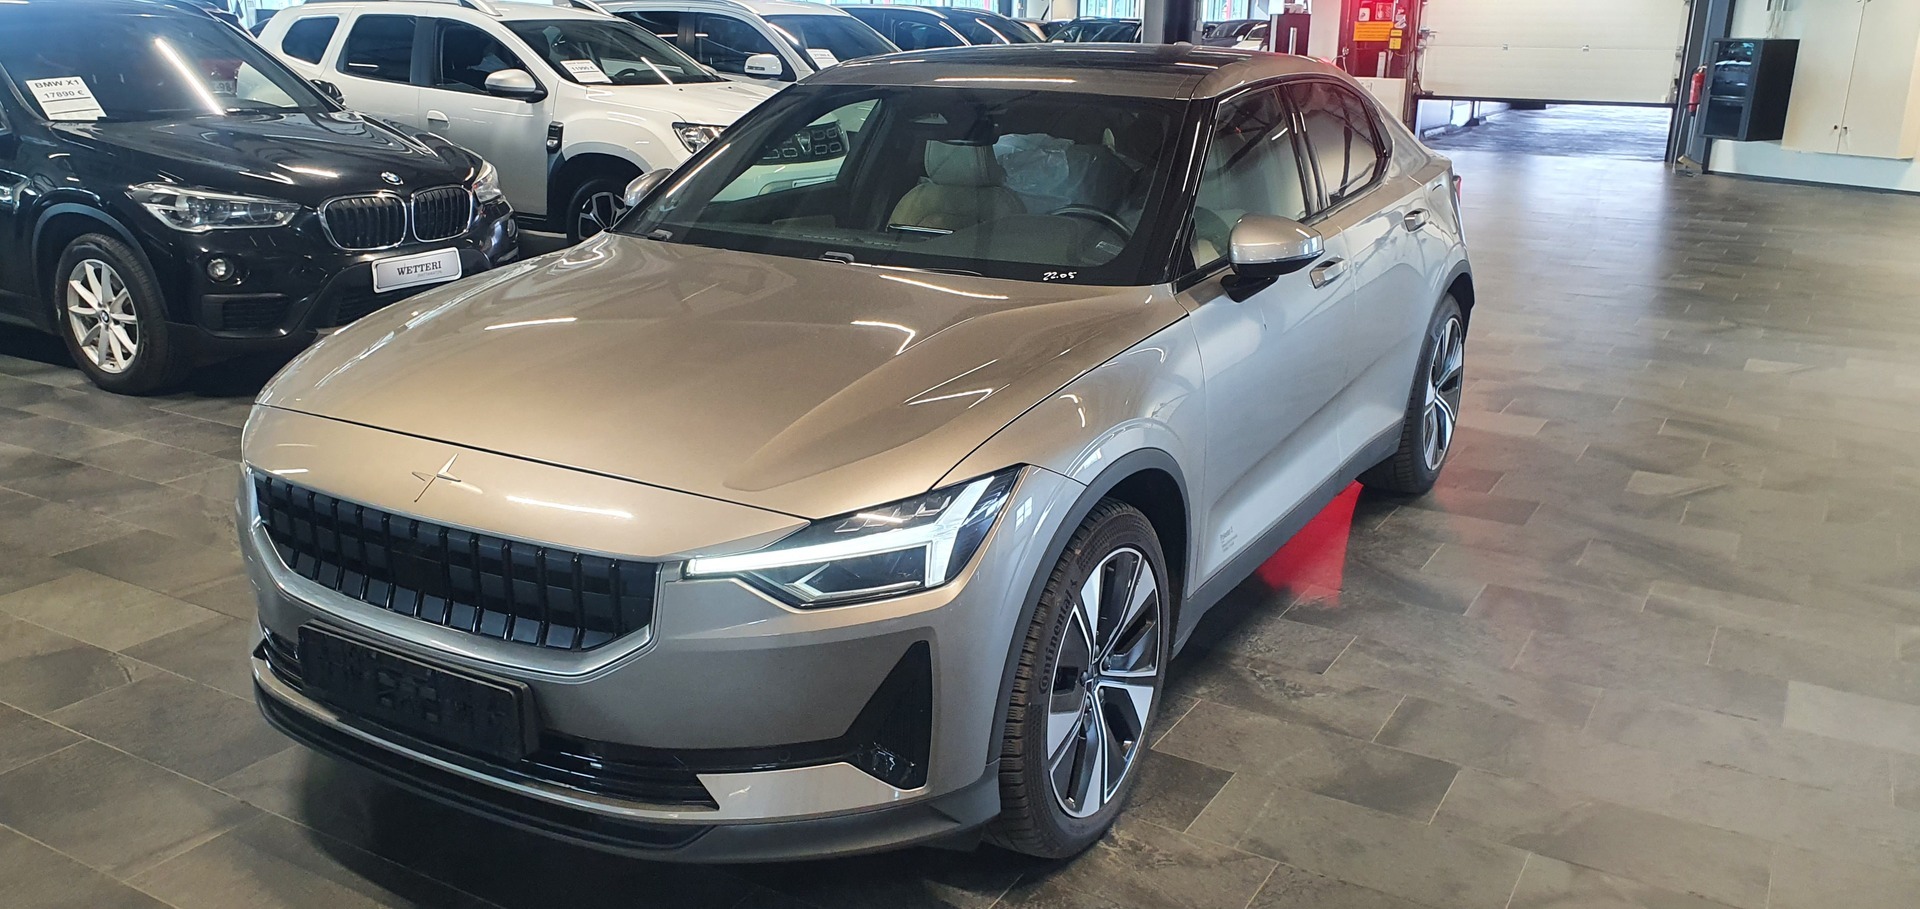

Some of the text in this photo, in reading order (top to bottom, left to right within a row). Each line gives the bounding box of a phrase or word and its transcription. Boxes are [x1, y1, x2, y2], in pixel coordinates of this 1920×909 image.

[34, 80, 63, 89] BMW
[44, 90, 75, 99] 17890
[396, 260, 442, 276] WETTERI
[1038, 589, 1073, 694] Continental
